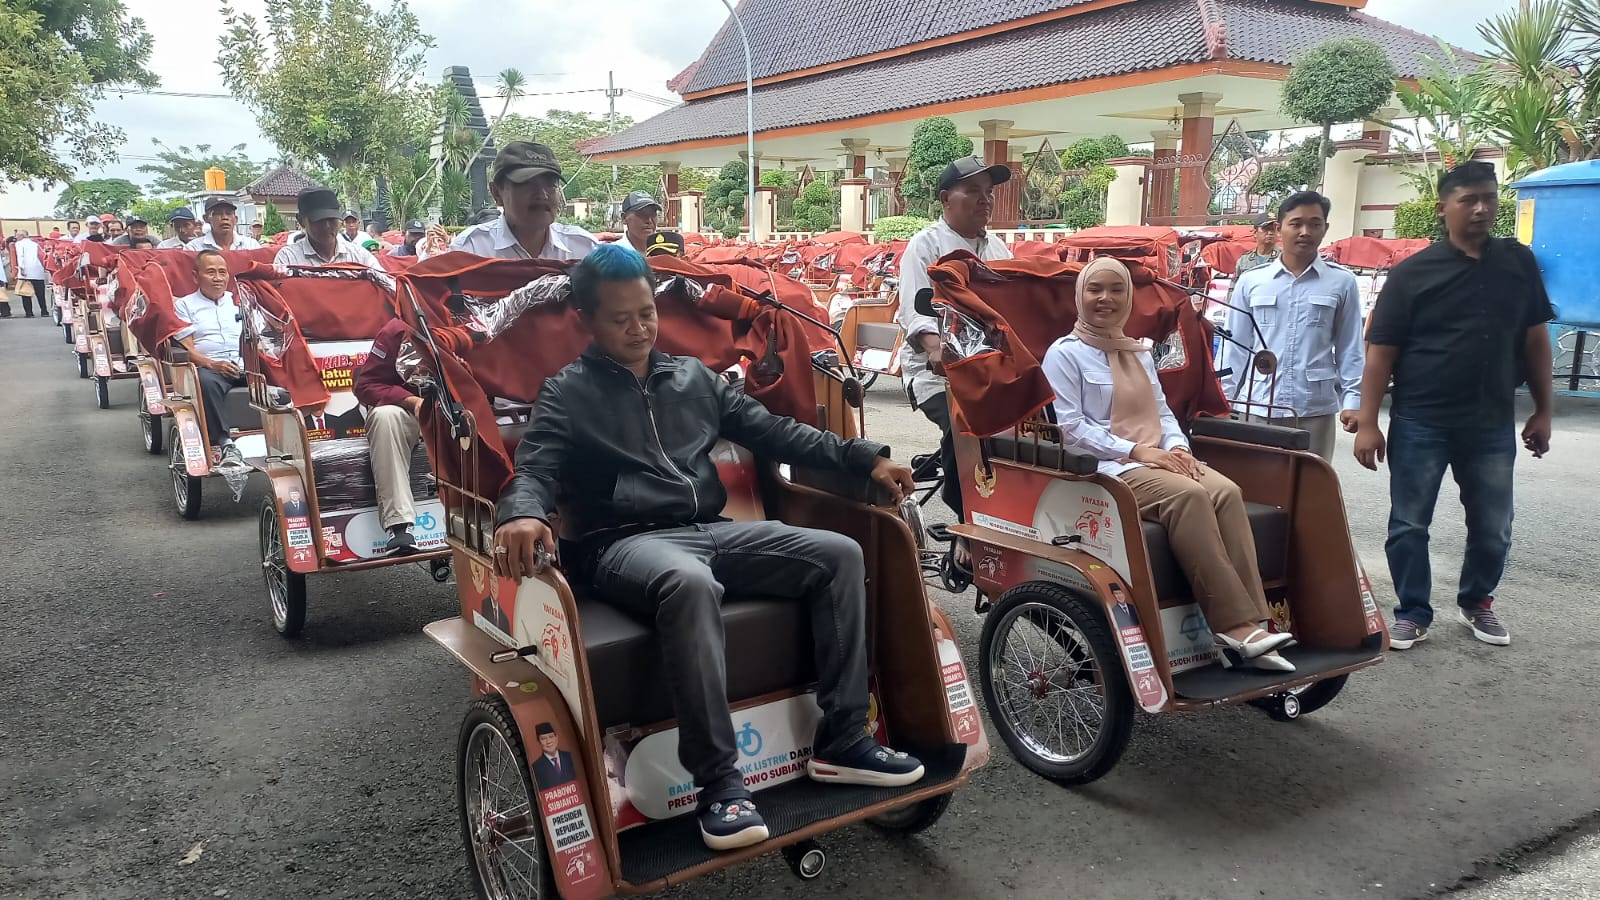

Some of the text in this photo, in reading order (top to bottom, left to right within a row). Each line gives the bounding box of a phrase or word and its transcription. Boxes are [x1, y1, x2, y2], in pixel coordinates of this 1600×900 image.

[1082, 495, 1109, 509] YAYASAN
[754, 753, 788, 771] LISTRIK
[790, 746, 812, 760] DARI
[545, 783, 577, 801] PRABOWO
[548, 794, 579, 812] SUBIANTO
[552, 809, 582, 827] PRESIDEN
[555, 819, 585, 837] REPUBLIK
[556, 831, 590, 849] INDONESIA
